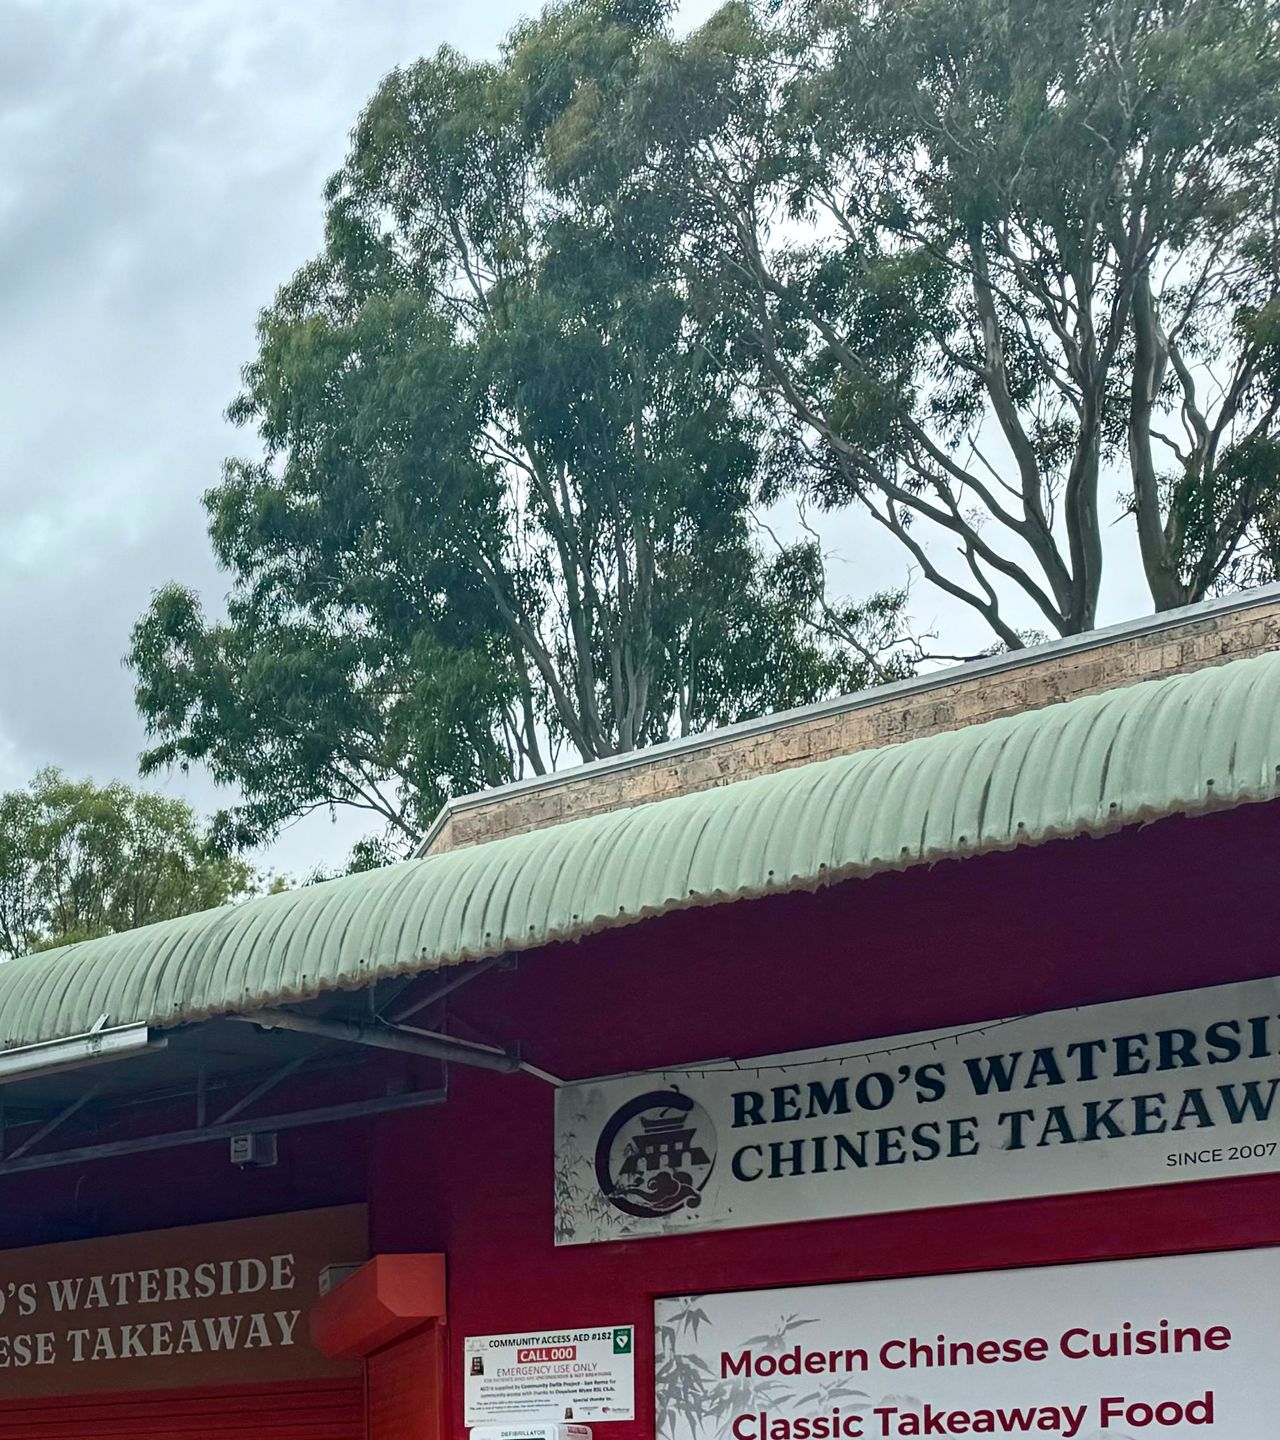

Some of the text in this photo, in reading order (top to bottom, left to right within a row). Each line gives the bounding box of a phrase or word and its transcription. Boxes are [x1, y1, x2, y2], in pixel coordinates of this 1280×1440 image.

[732, 1014, 1280, 1128] REMO'S WATERSI
[732, 1116, 981, 1183] CHINESE
[1166, 1142, 1278, 1167] SINCE 2007
[47, 1253, 297, 1312] WATERSIDE
[66, 1309, 302, 1361] TAKEAWAY
[489, 1337, 540, 1348] COMMUNITY
[541, 1334, 571, 1344] ACCESS
[573, 1333, 589, 1342] AED
[591, 1332, 612, 1341] #182
[520, 1348, 573, 1362] CALL 000
[720, 1319, 1231, 1379] Modern Chinese Cuisine
[497, 1362, 598, 1377] EMERGENCY USE ONLY
[874, 1398, 1086, 1440] Takeaway
[1098, 1391, 1214, 1428] Food
